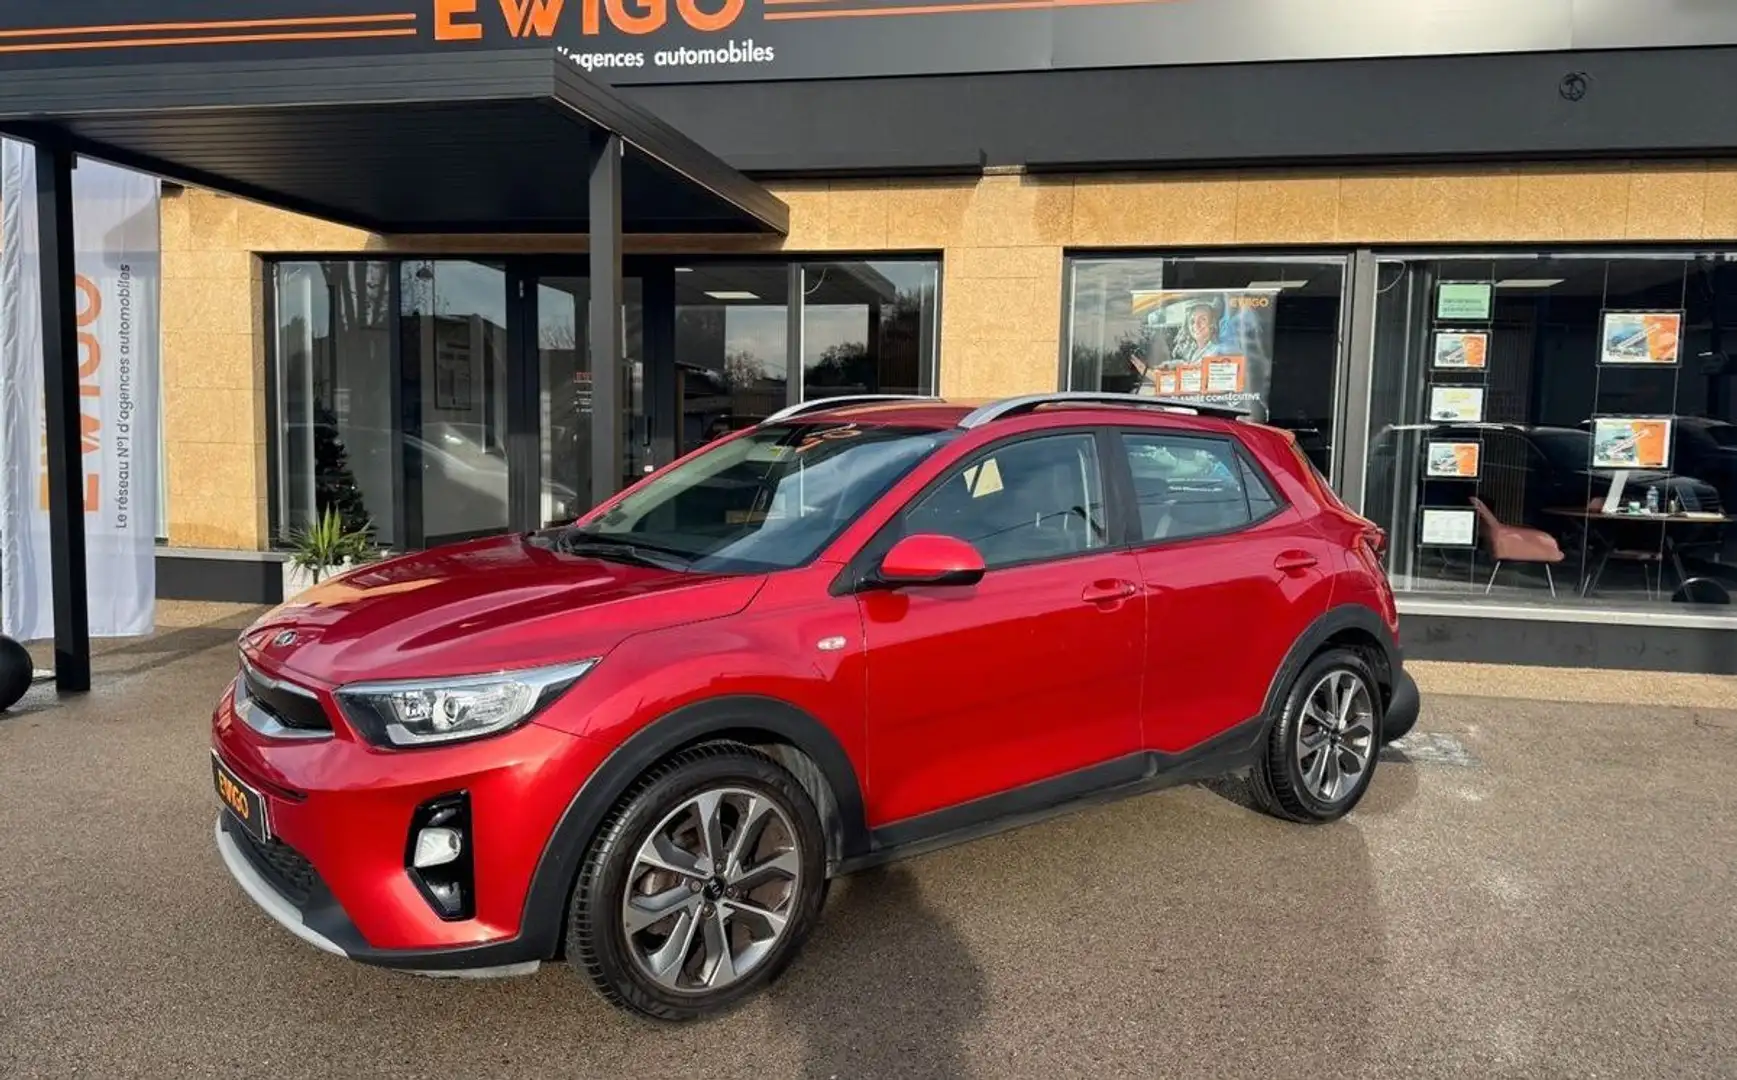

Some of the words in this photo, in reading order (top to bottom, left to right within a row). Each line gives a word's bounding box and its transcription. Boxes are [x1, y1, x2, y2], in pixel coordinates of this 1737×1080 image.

[654, 39, 774, 66] automobiles
[117, 264, 131, 354] automobiles
[117, 359, 133, 433] d'agences
[116, 462, 129, 511] réseau
[116, 517, 128, 529] Le
[218, 769, 249, 820] EWIGO
